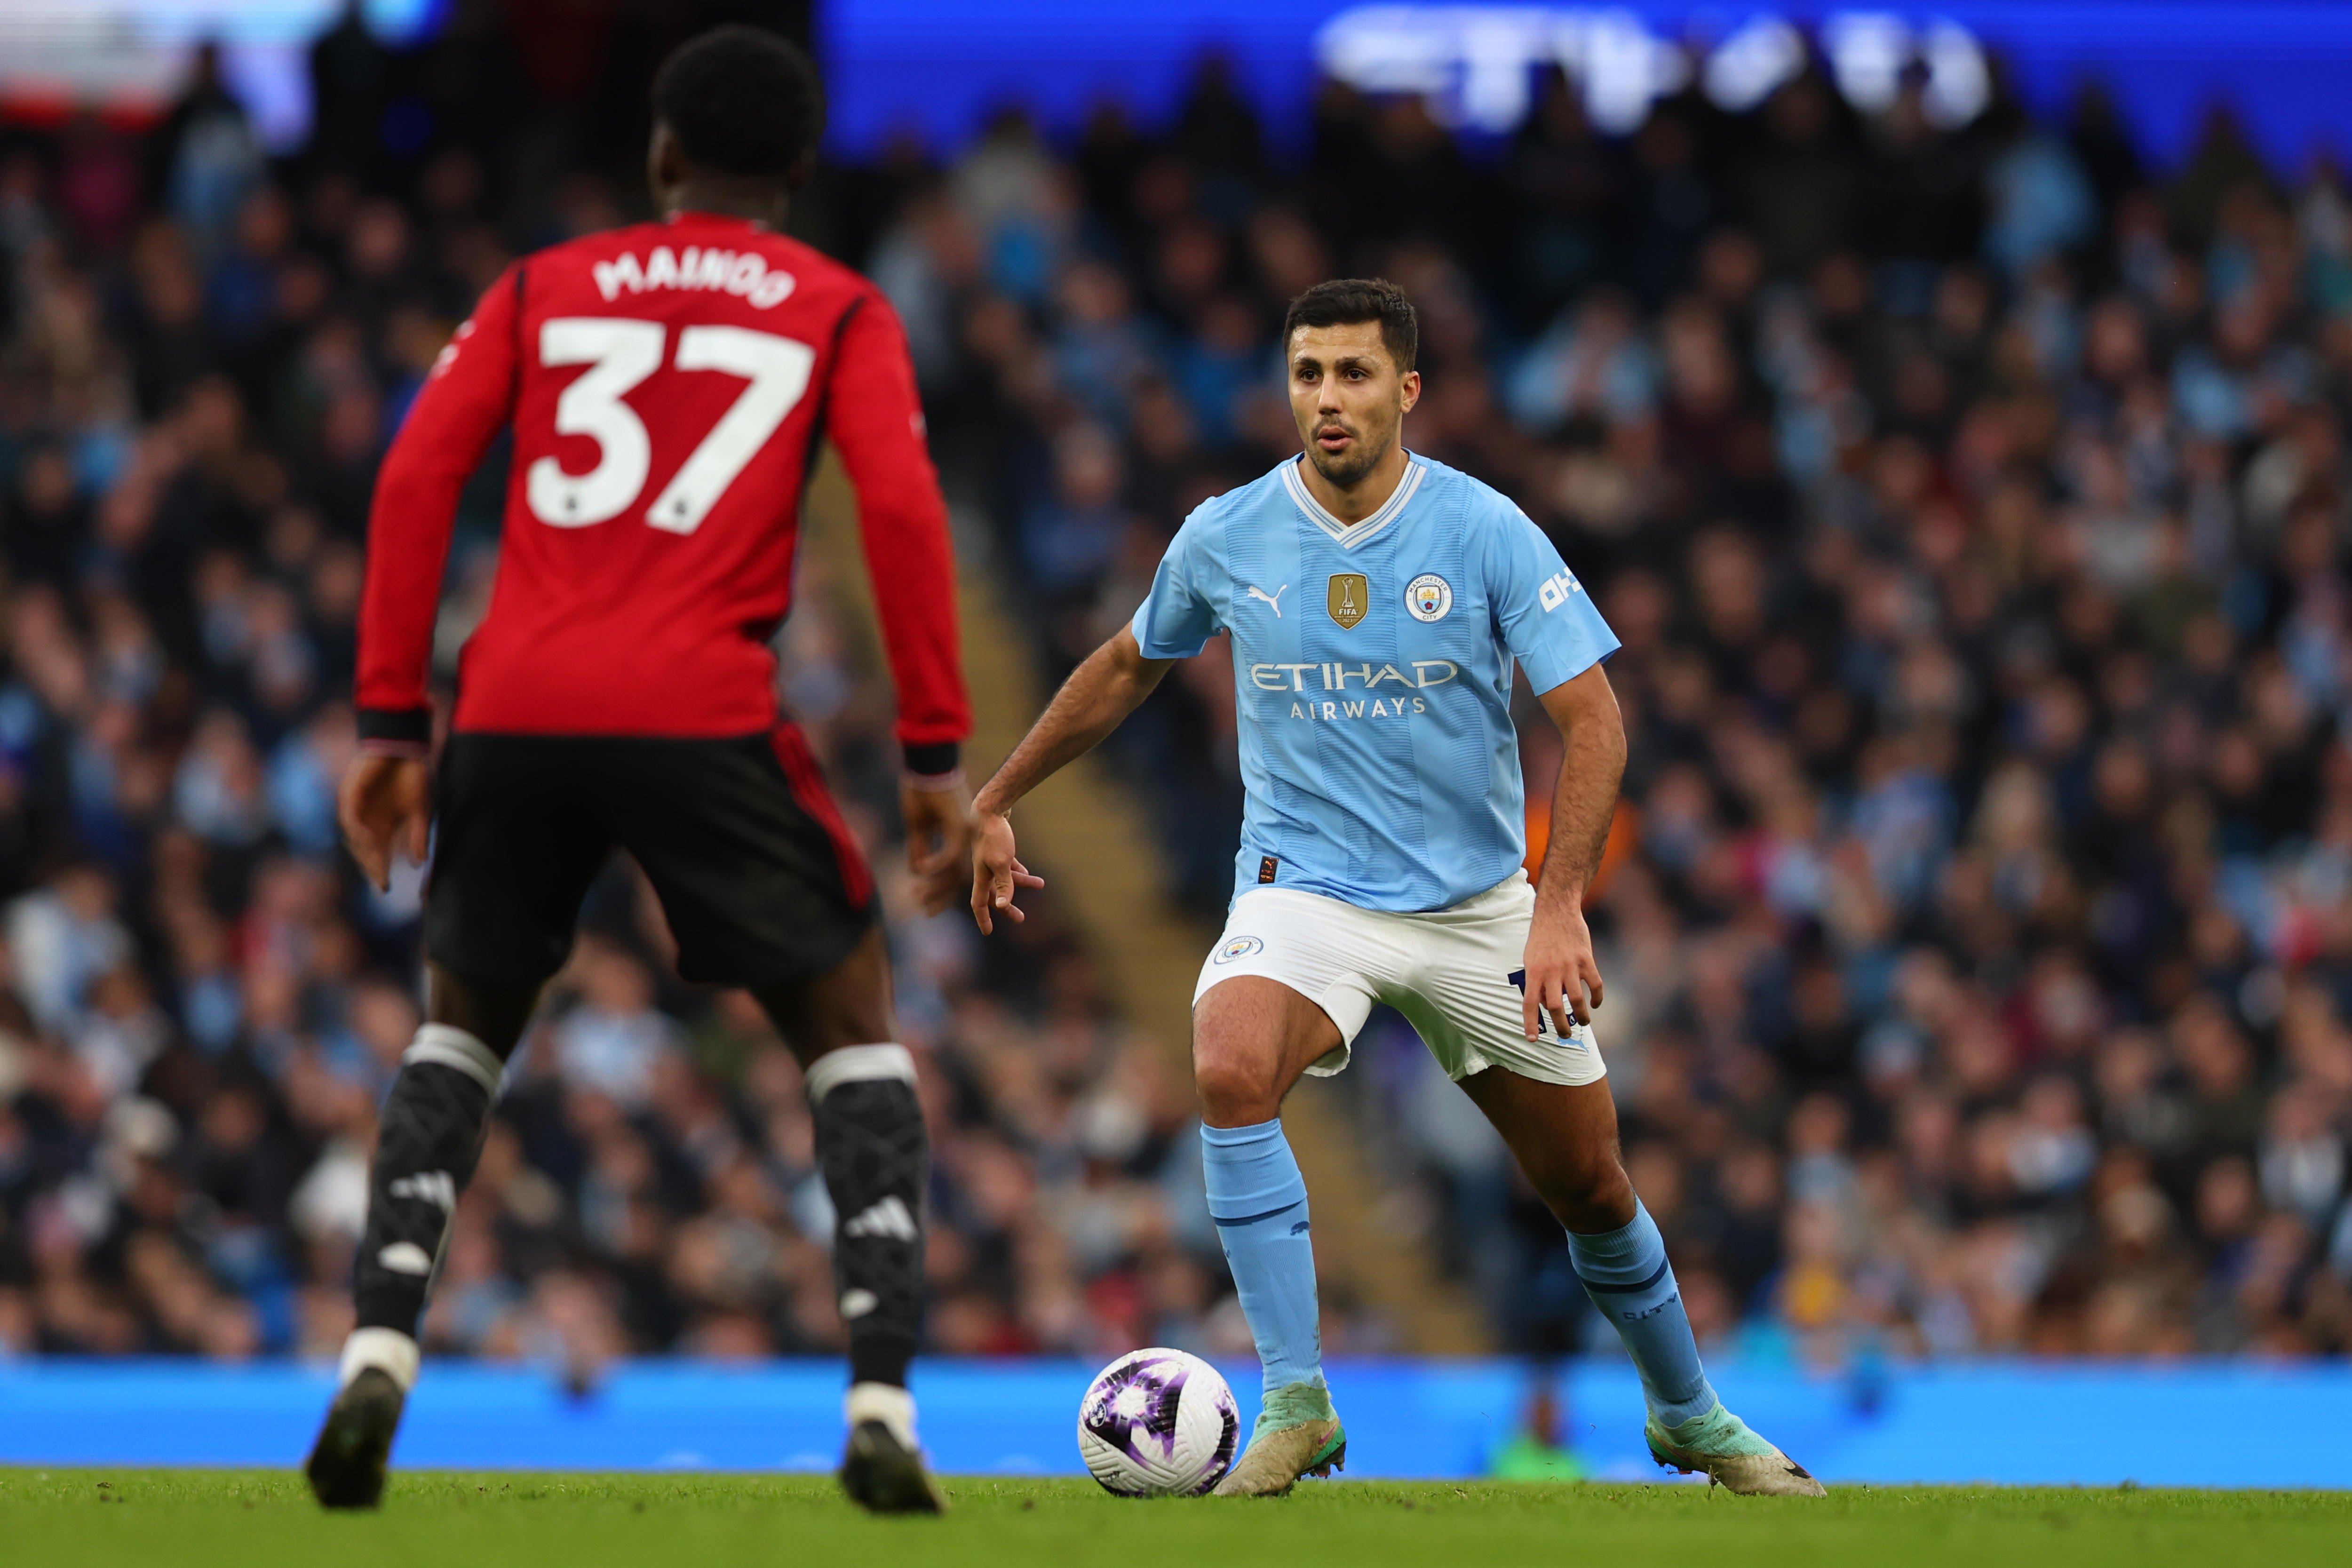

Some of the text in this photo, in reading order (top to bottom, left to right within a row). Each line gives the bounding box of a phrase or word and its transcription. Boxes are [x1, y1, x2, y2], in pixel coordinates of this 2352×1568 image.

[592, 246, 796, 309] MAINOO
[526, 317, 816, 536] 37
[1409, 577, 1447, 593] MANCHESTER
[1251, 660, 1457, 692] ETIHAD
[1290, 697, 1425, 720] AIRWAYS
